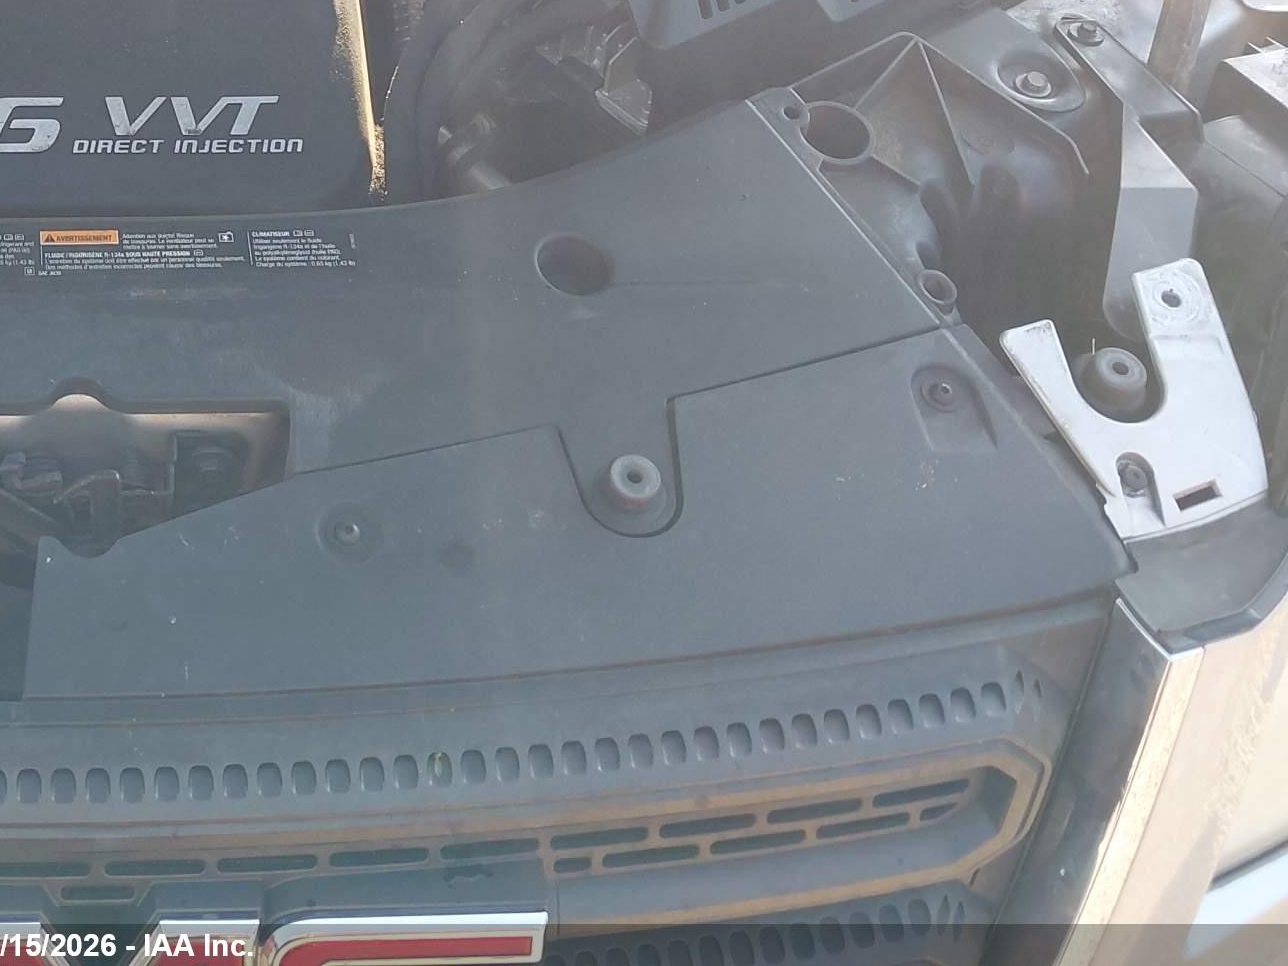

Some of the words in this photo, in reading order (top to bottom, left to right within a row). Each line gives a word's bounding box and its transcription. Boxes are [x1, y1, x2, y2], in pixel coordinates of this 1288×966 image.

[104, 95, 280, 135] VVT
[72, 138, 165, 154] DIRECT
[173, 138, 303, 154] INJECTION
